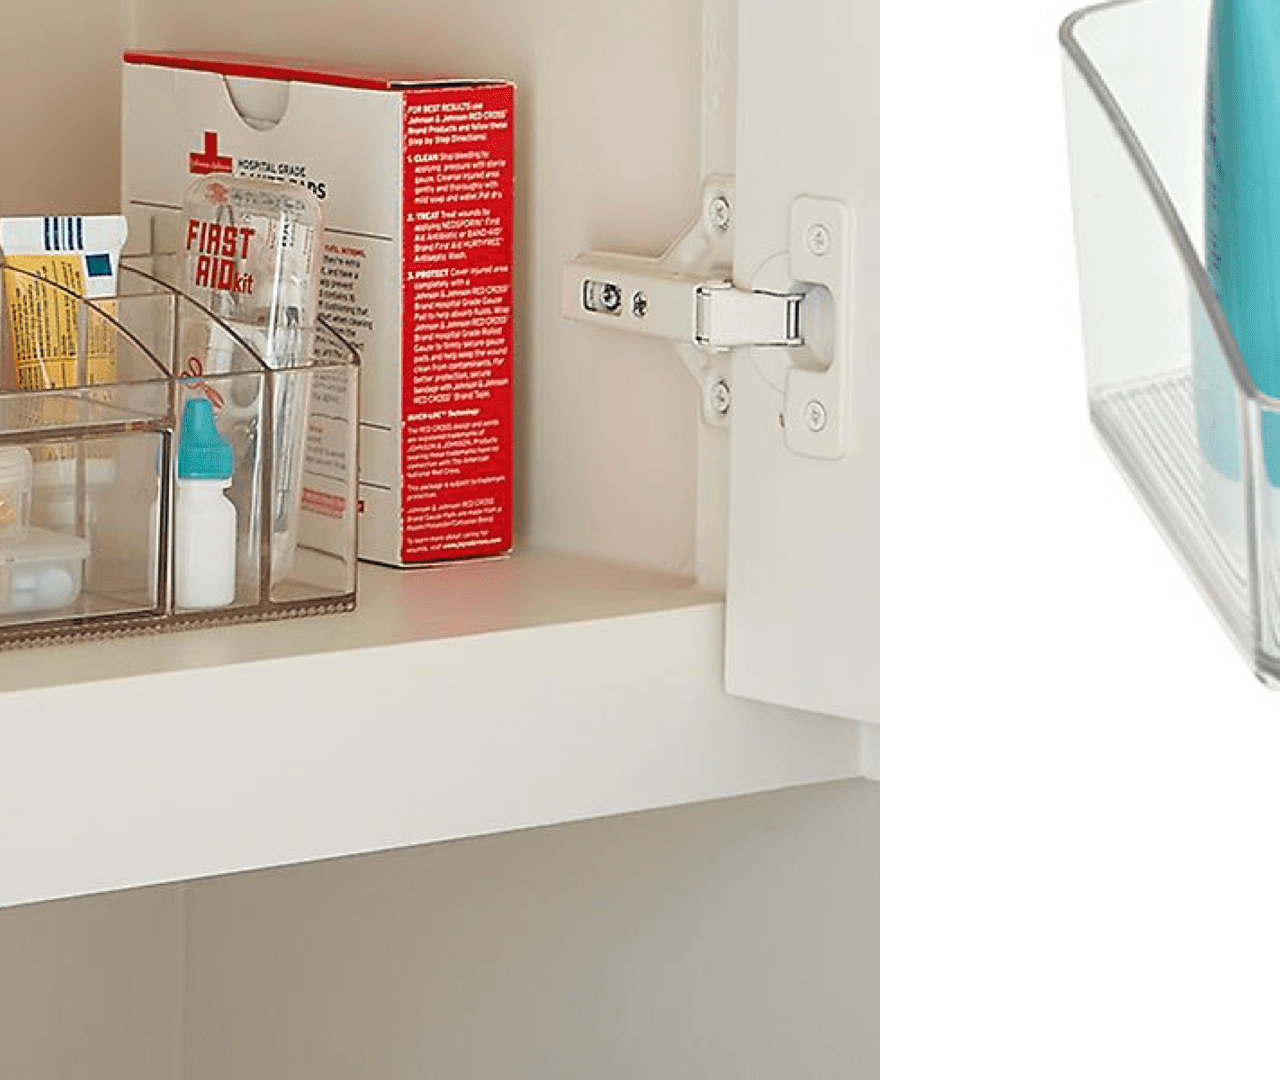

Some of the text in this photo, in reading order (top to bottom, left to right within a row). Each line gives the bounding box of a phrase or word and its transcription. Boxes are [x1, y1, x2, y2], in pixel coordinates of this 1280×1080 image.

[187, 219, 256, 259] FIRST
[195, 255, 254, 295] AID kit
